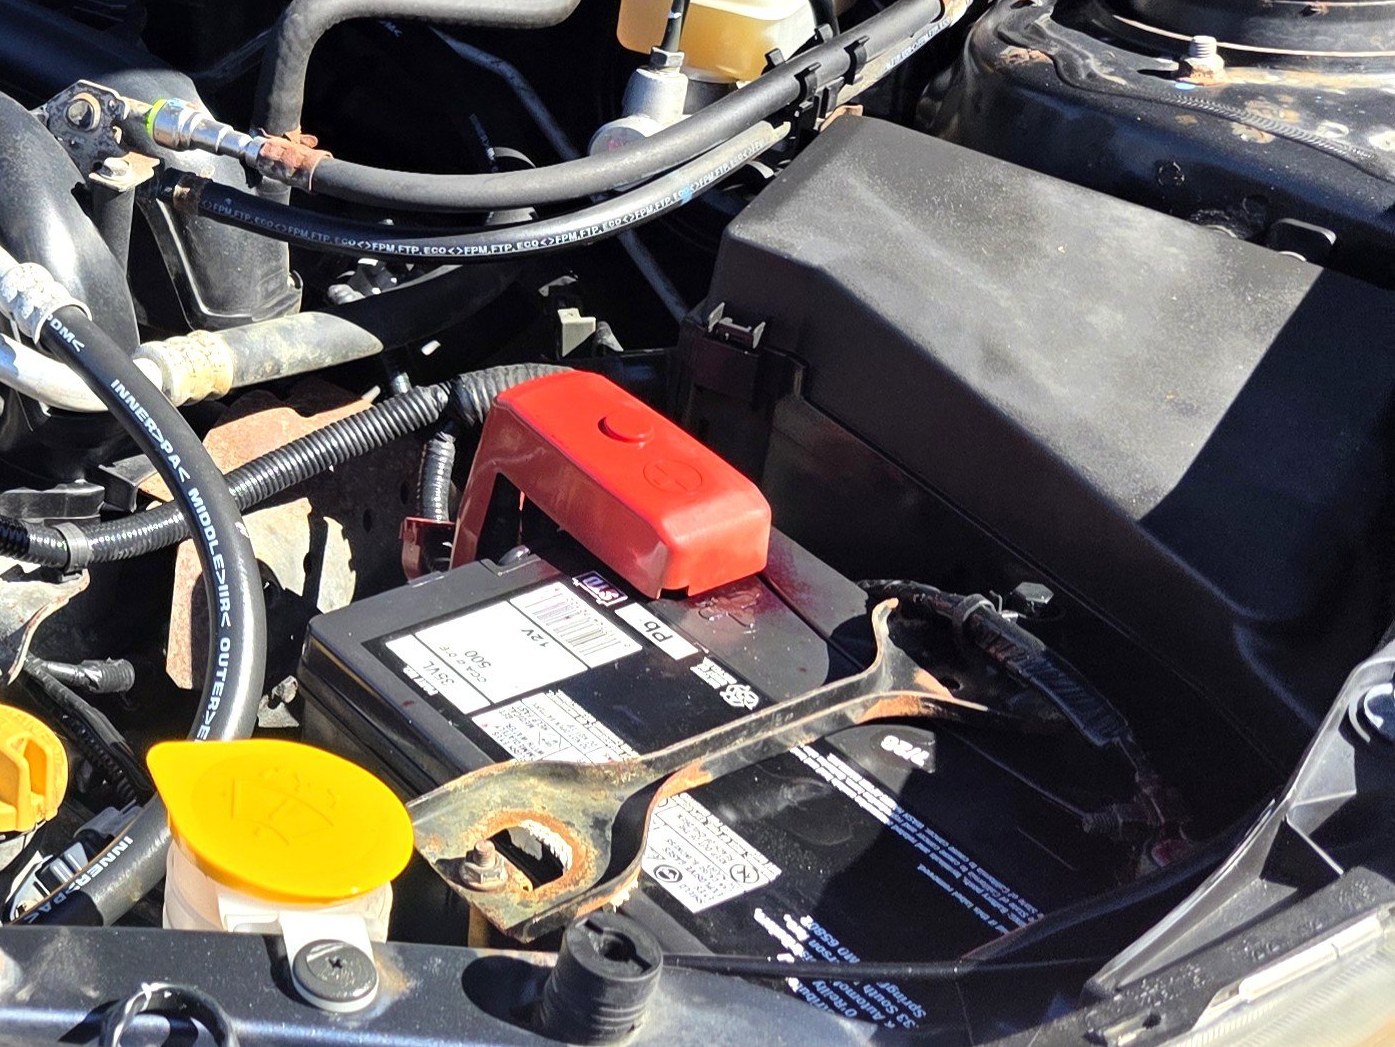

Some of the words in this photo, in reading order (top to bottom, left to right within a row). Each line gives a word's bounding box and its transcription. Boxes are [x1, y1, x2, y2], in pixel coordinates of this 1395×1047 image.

[520, 626, 551, 647] 12V
[638, 619, 674, 642] Pb
[462, 649, 493, 669] 500
[417, 660, 456, 686] 35VL
[193, 637, 232, 741] OUTER>E
[807, 979, 862, 1018] O'Reilly
[857, 983, 901, 1014] South
